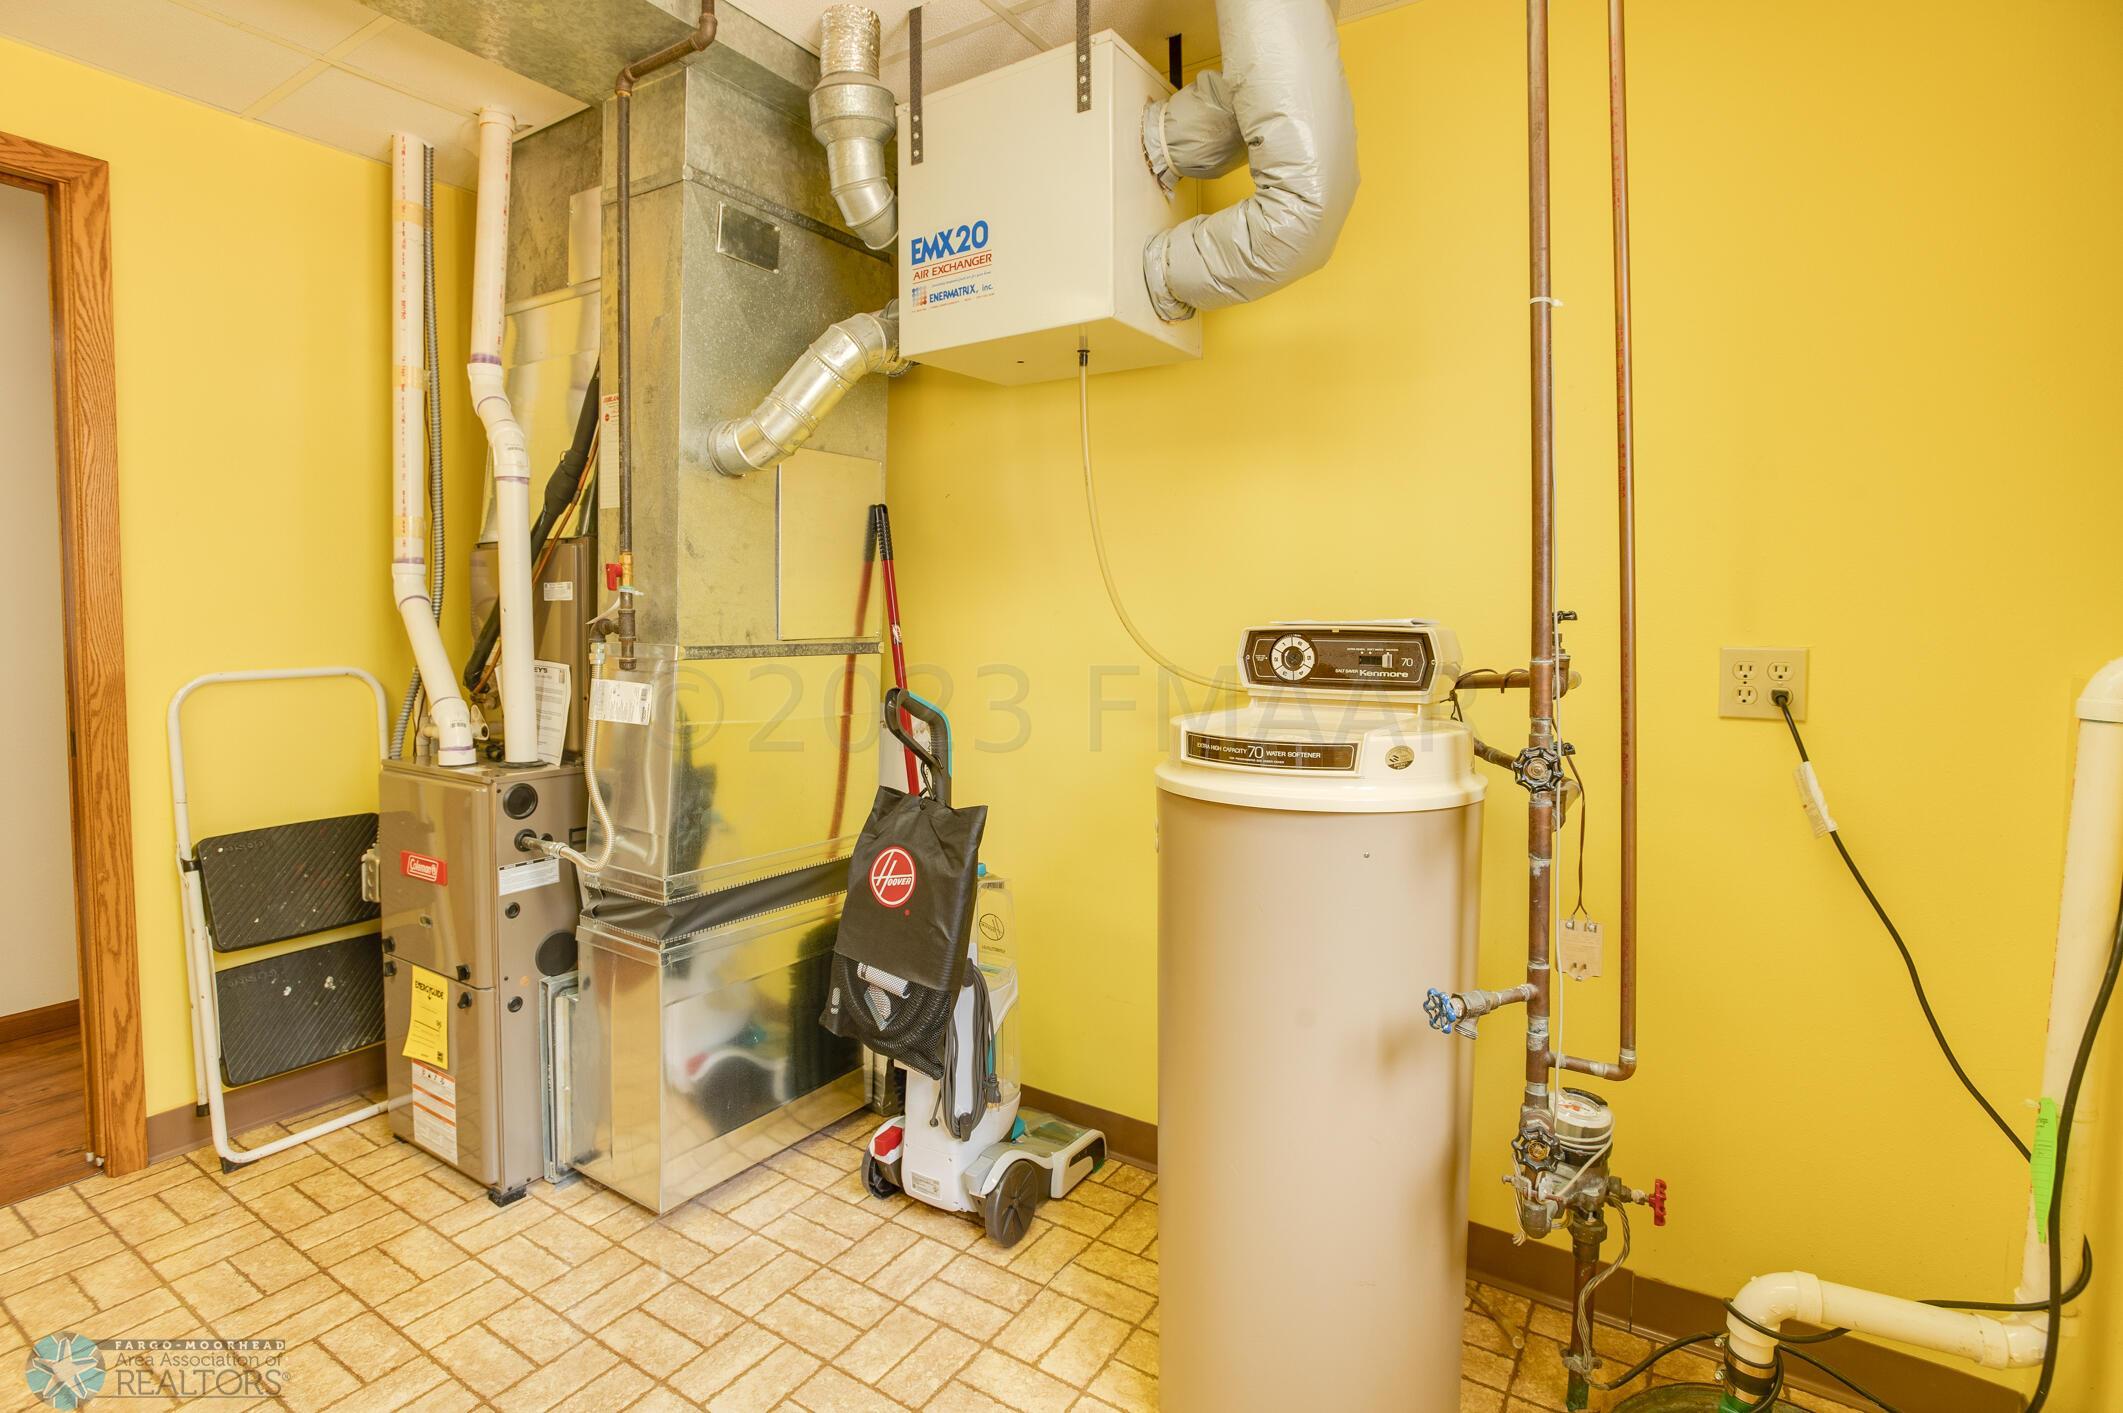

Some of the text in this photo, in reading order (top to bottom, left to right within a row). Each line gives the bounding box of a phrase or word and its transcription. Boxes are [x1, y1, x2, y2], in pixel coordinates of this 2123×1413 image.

[911, 220, 988, 265] EMX20
[913, 269, 929, 280] AIR
[932, 253, 992, 276] EXCHANGER
[1401, 657, 1414, 667] 70
[1360, 669, 1409, 678] Kenmore
[1222, 746, 1247, 754] CAPACITY
[1247, 745, 1264, 759] 70
[1287, 751, 1321, 759] SOFTENER
